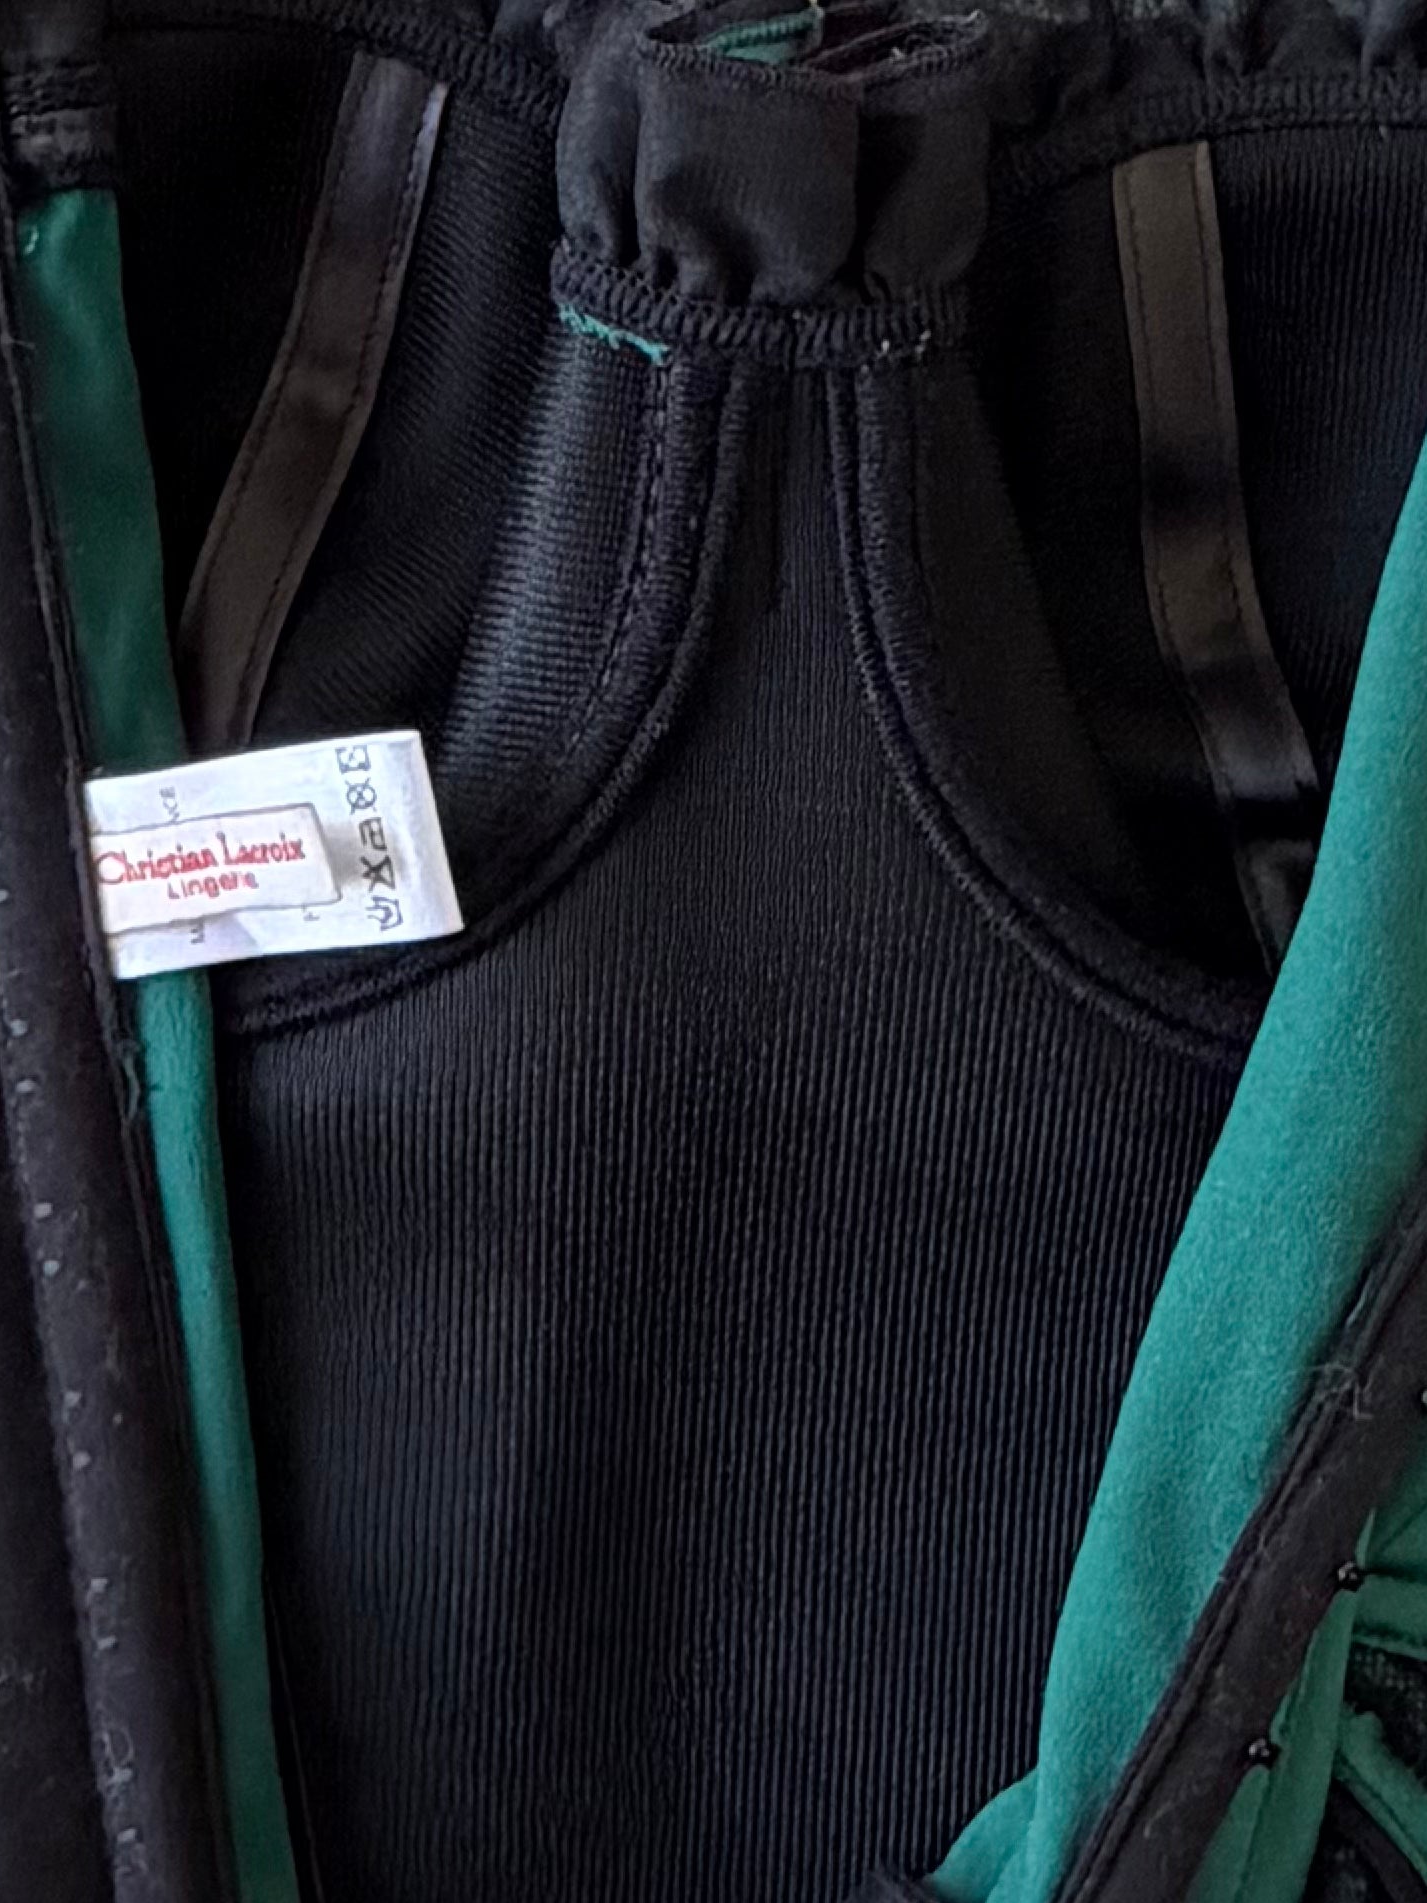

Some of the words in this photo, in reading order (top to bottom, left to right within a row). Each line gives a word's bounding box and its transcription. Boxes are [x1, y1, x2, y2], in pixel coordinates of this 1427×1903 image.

[95, 843, 218, 885] Christian
[216, 831, 306, 865] Lacroix
[168, 871, 260, 899] Lingerie
